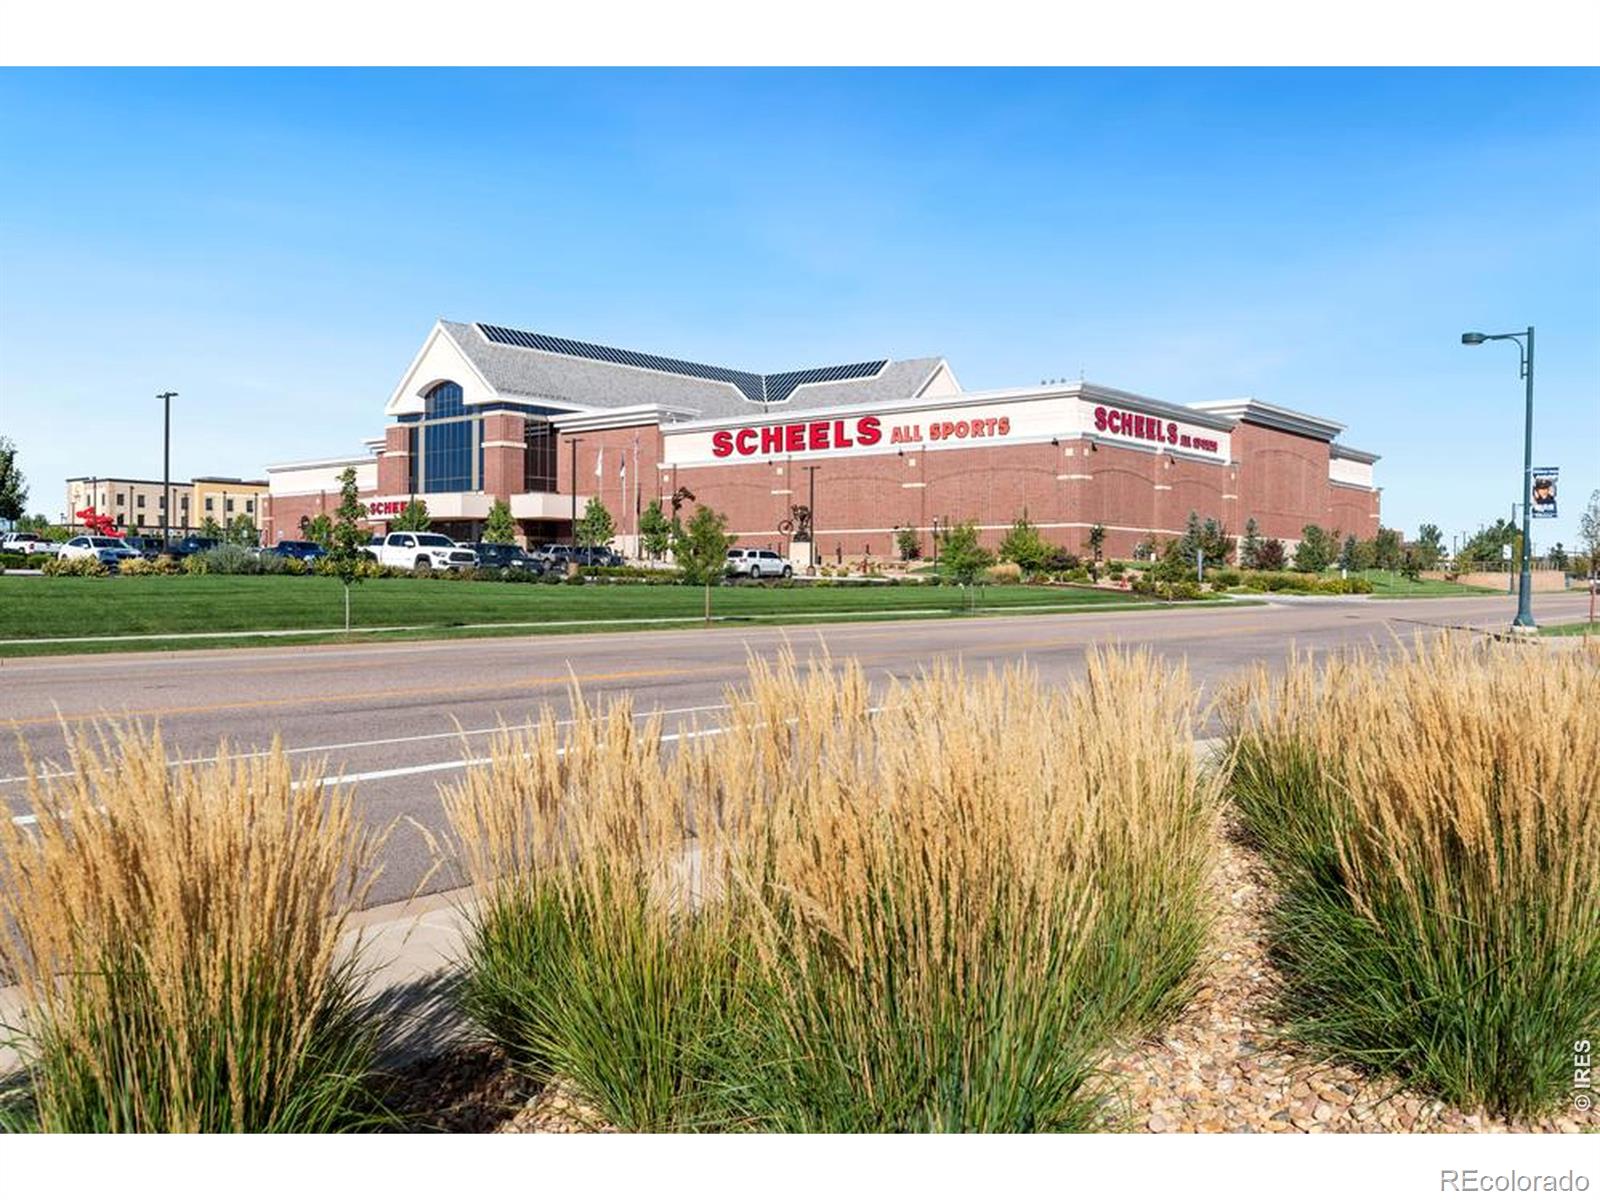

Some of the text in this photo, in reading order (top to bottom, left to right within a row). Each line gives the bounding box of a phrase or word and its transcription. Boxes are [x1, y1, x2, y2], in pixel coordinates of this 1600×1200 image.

[712, 416, 1011, 458] SCHEELS ALL SPORTS
[1094, 406, 1178, 445] SCHEELS
